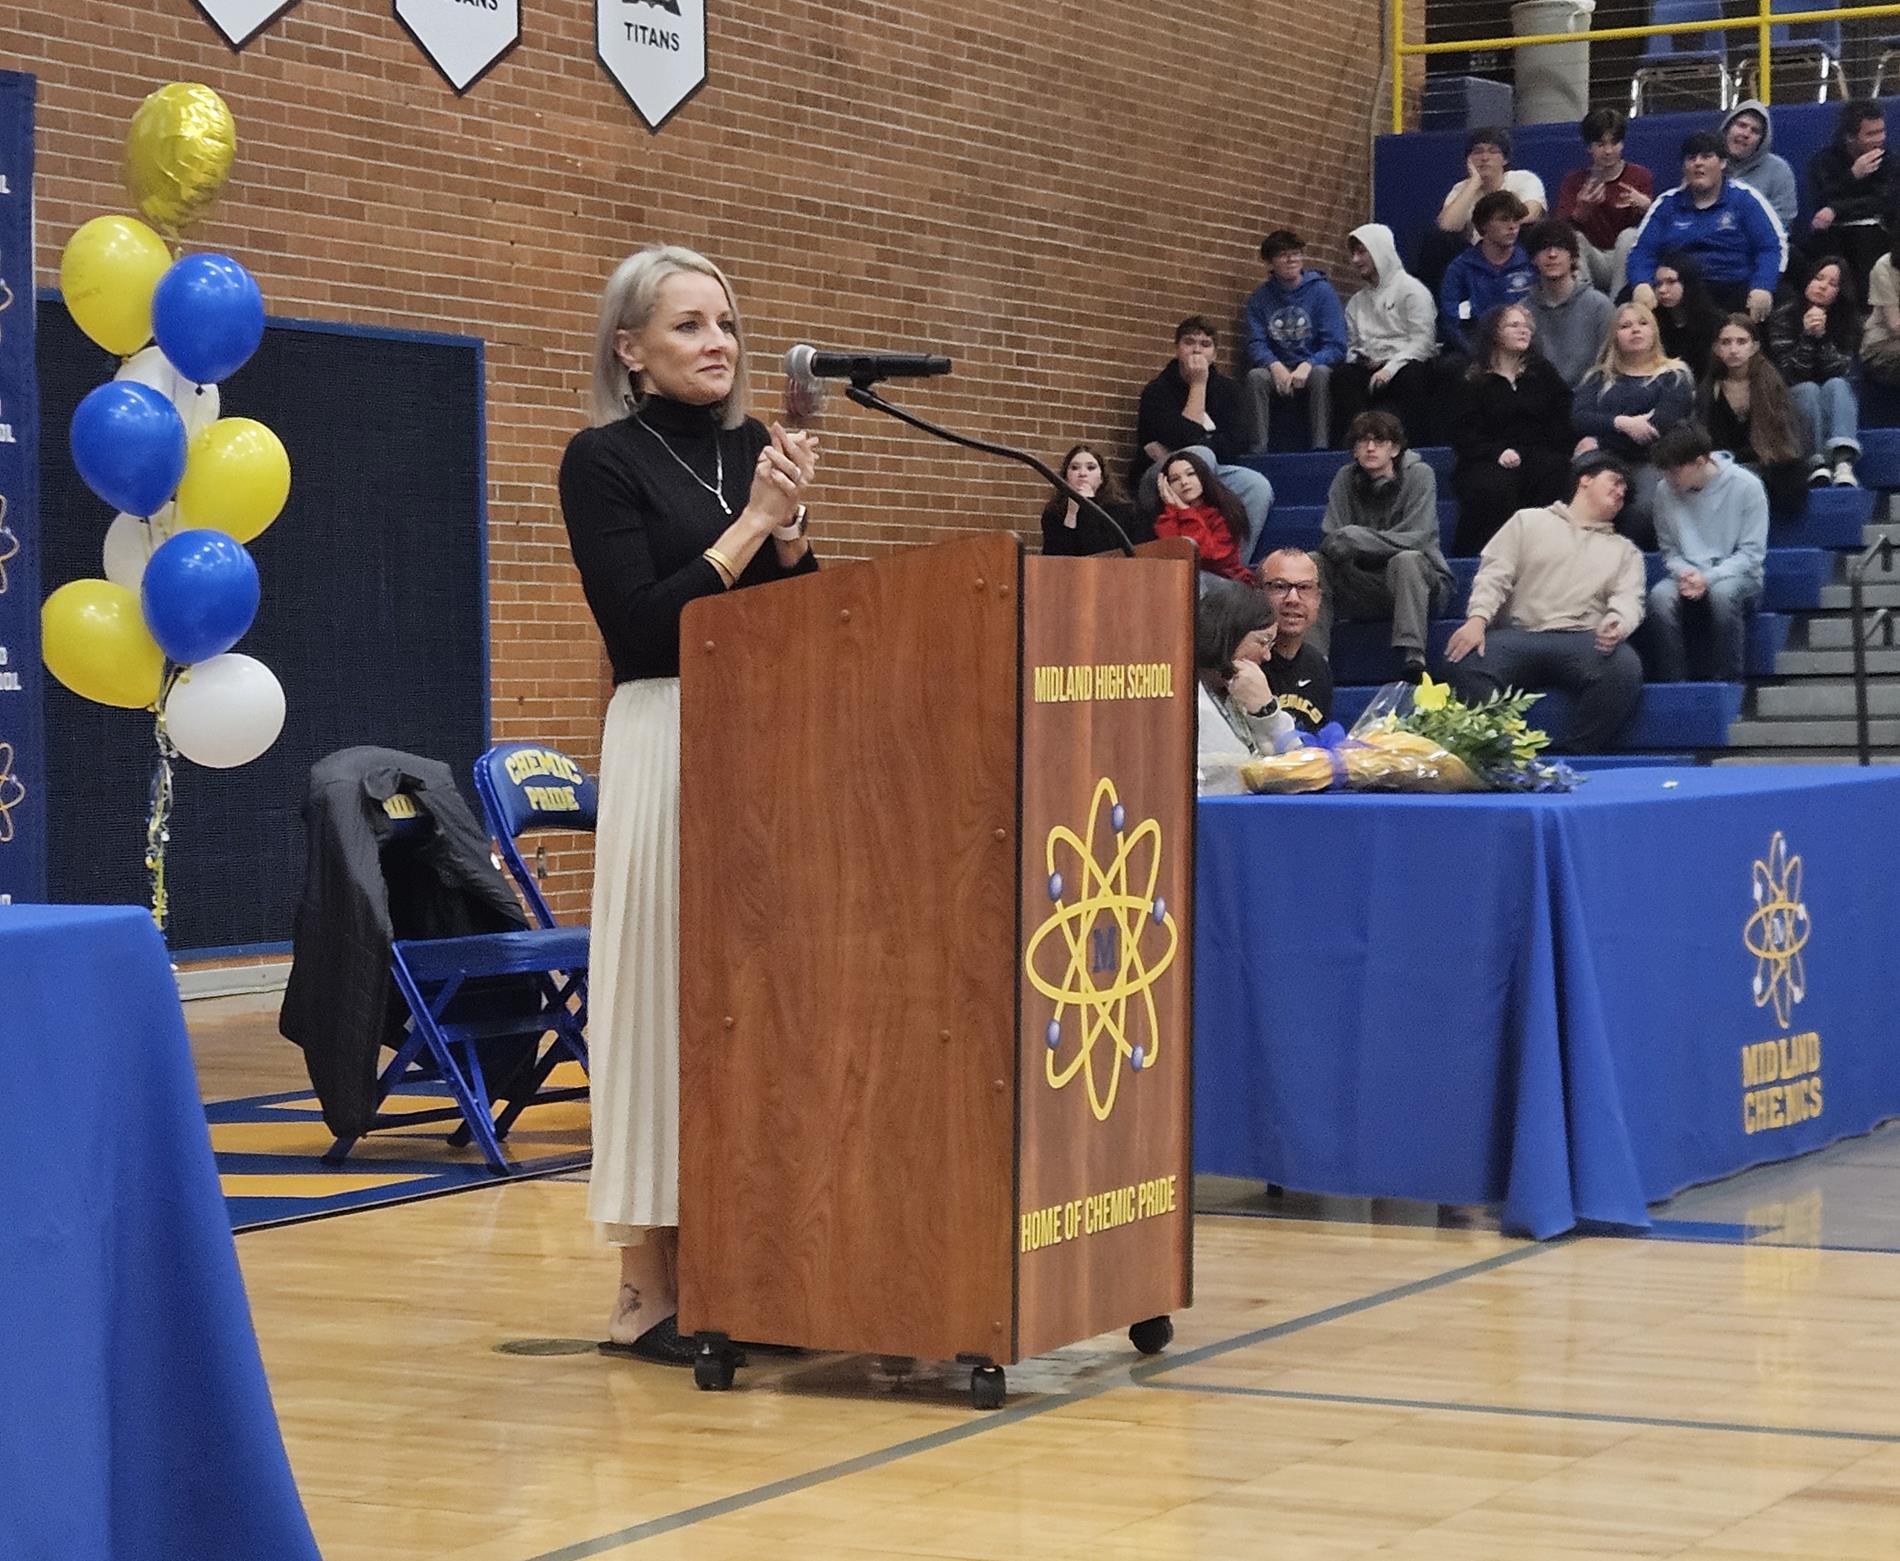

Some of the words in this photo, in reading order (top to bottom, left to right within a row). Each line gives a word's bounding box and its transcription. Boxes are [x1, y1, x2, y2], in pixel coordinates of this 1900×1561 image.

[624, 22, 680, 52] TITANS
[1034, 665, 1092, 703] MIDLAND
[1095, 664, 1125, 700] HIGH
[1127, 663, 1174, 699] SCHOOL
[505, 749, 583, 786] CHEMIC
[524, 785, 580, 811] PRIDE
[1093, 926, 1117, 973] M
[1021, 1205, 1062, 1253] HOME
[1064, 1200, 1083, 1241] OF
[1085, 1186, 1136, 1235] CHEMIC
[1138, 1175, 1177, 1220] PRIDE
